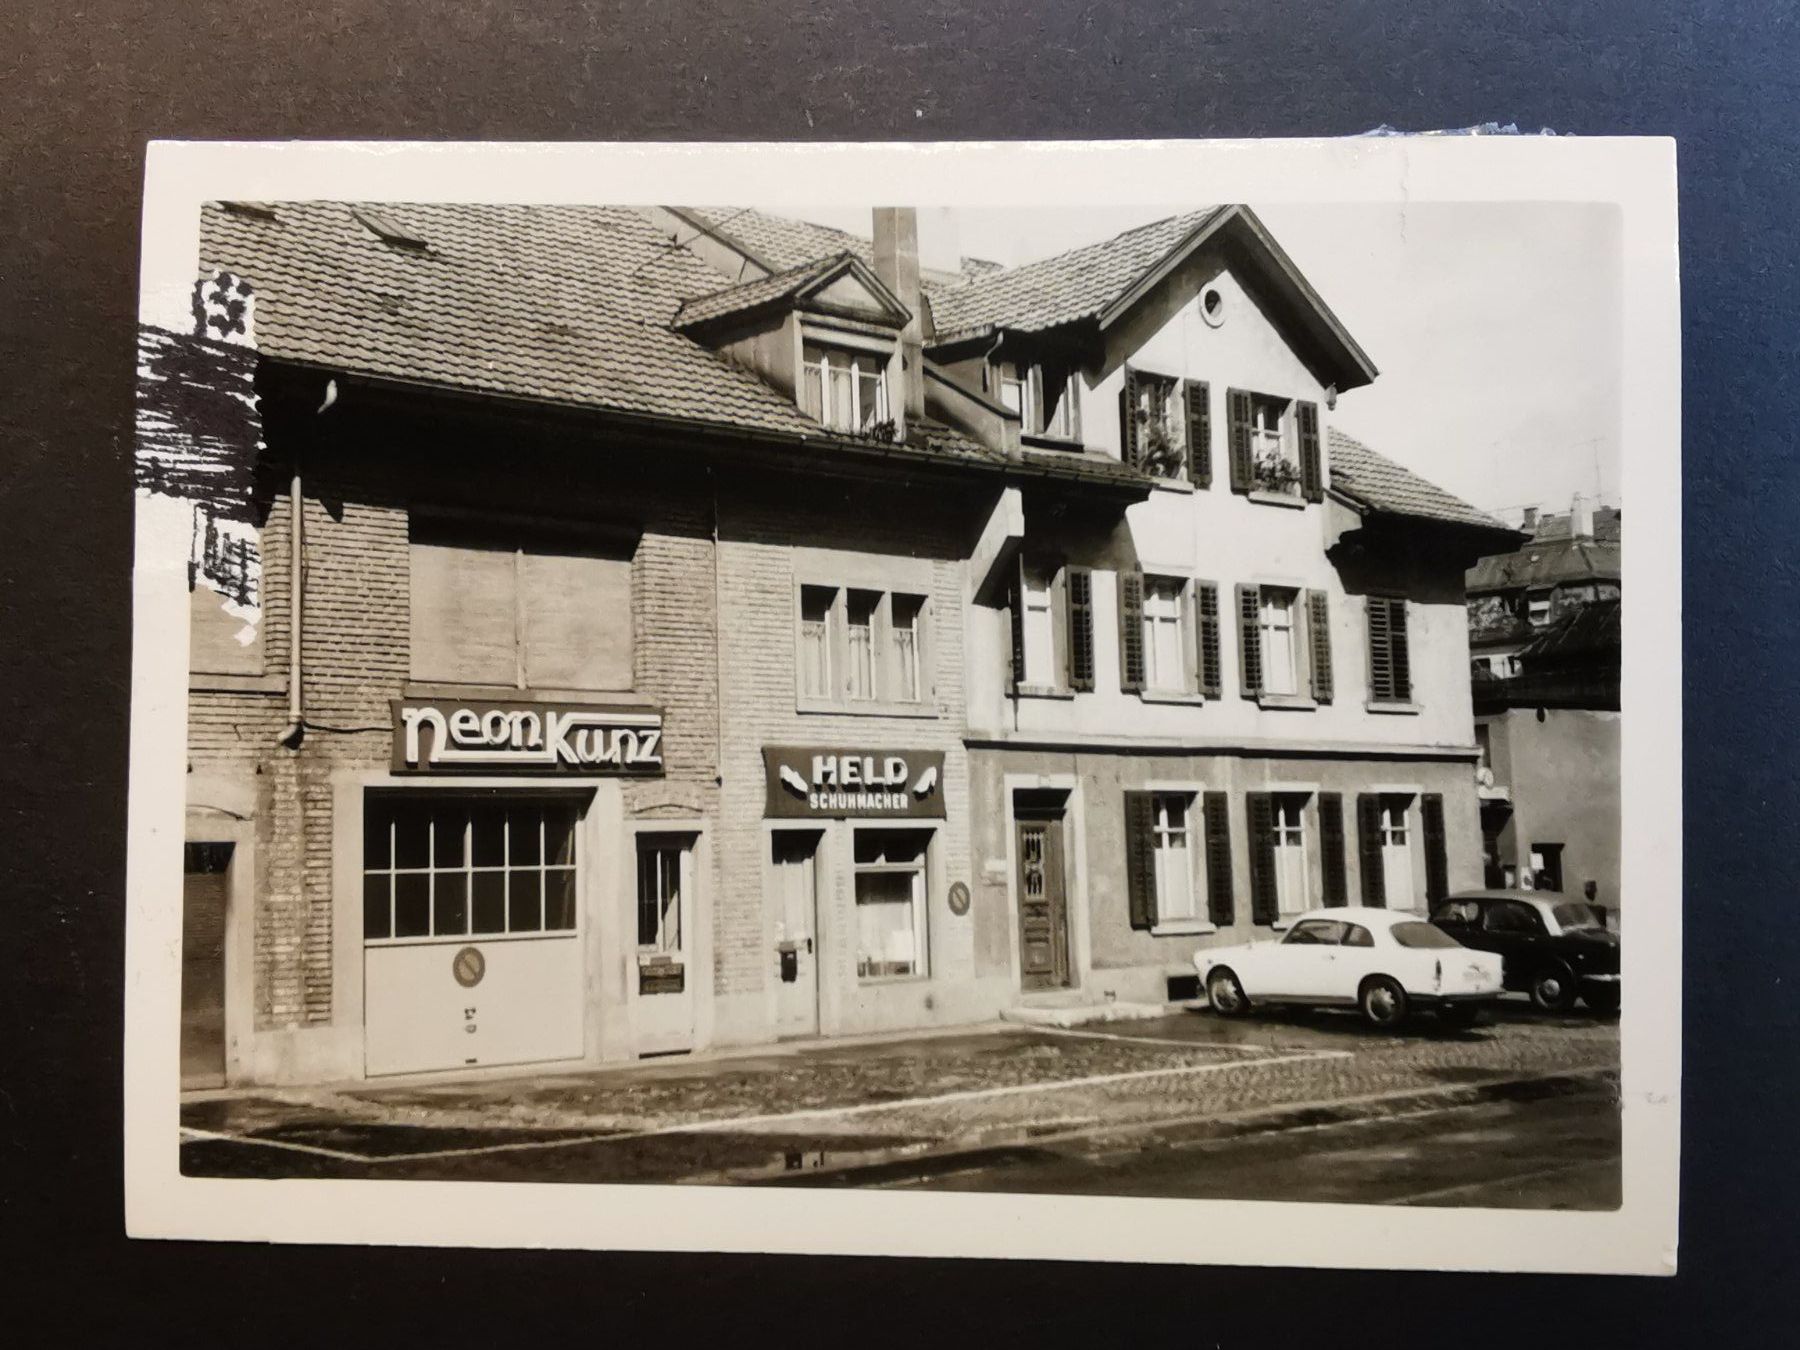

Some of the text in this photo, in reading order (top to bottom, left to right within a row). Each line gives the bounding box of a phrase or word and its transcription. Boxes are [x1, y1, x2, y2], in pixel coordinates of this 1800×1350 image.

[545, 710, 662, 764] Kunz
[812, 755, 908, 786] HELD
[809, 793, 909, 810] SCHUHMACHER
